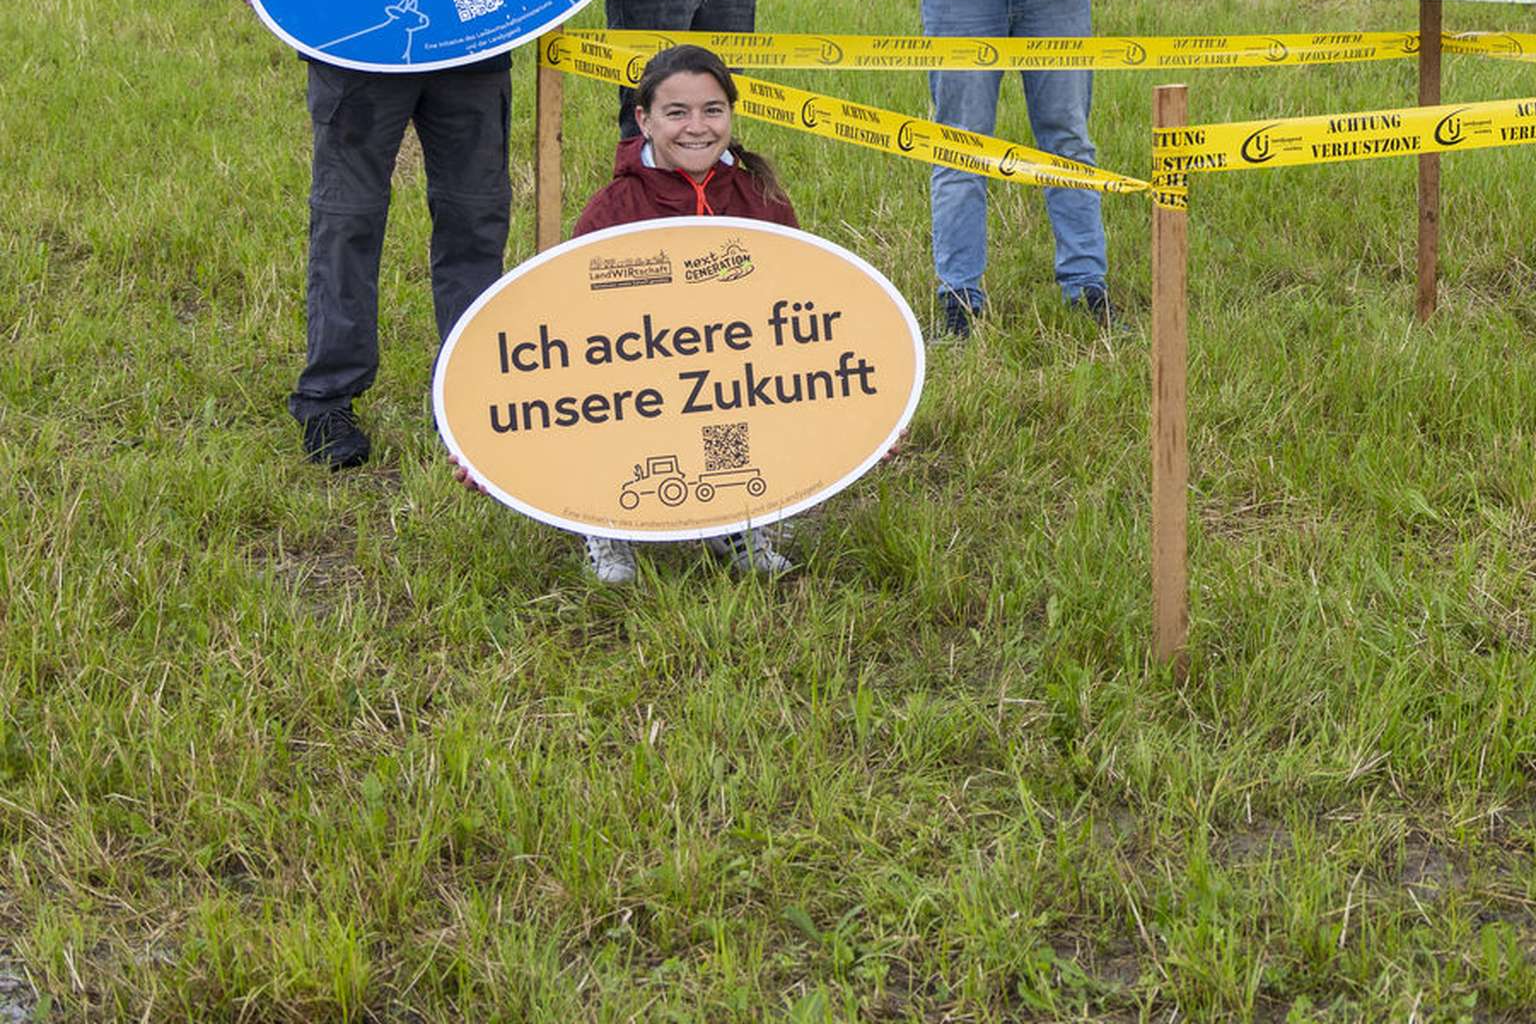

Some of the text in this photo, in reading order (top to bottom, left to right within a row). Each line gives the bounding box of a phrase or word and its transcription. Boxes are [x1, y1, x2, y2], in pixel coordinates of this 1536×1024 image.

[1327, 114, 1401, 134] ACHTUNG
[1312, 136, 1421, 159] VERLUSTZONE
[685, 254, 752, 281] GENERATION
[498, 300, 841, 374] Ich ackere für
[489, 352, 877, 433] unsere Zukunft
